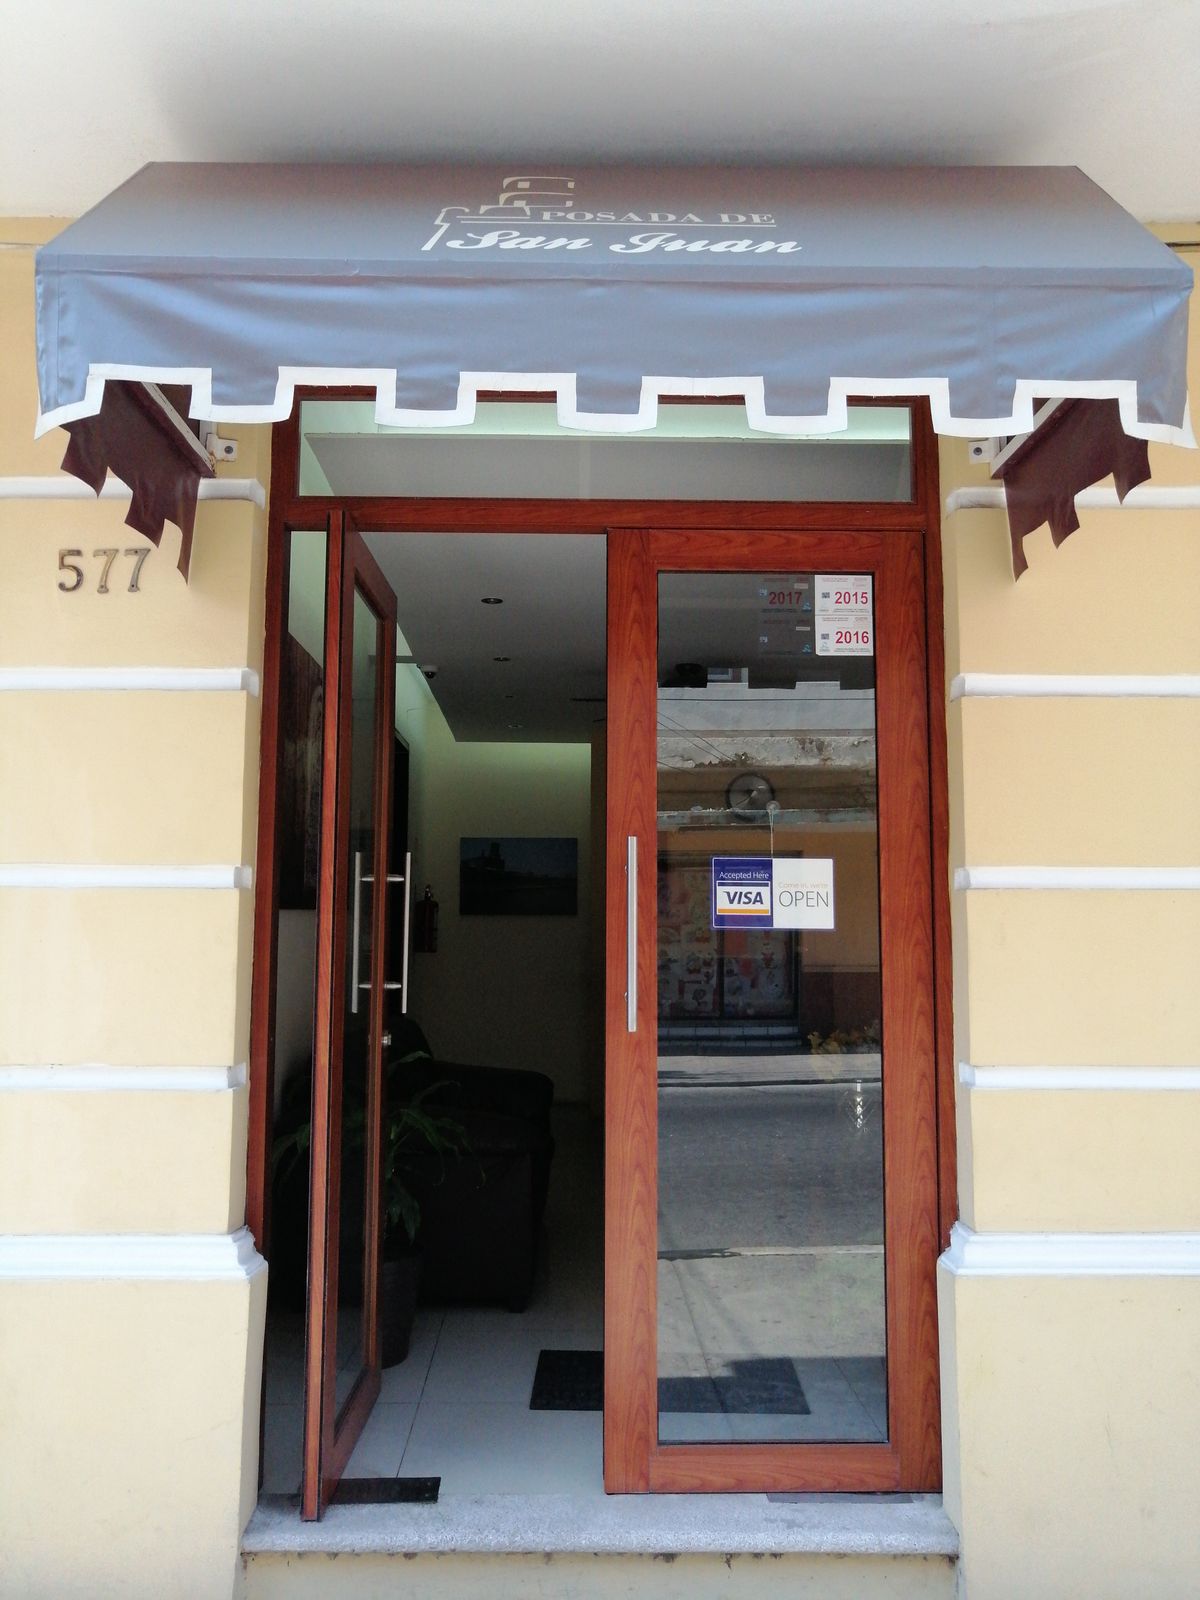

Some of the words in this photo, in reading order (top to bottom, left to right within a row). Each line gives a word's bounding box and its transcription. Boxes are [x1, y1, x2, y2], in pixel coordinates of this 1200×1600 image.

[541, 211, 704, 224] POSADA
[719, 213, 776, 225] DE
[445, 230, 594, 250] San
[608, 232, 802, 255] Juan
[58, 548, 151, 593] 577
[768, 591, 802, 605] 2017
[834, 591, 868, 605] 2015
[835, 631, 870, 644] 2016
[719, 871, 752, 880] Accepted
[753, 871, 769, 879] Here
[723, 891, 764, 905] VISA
[778, 890, 829, 907] OPEN
